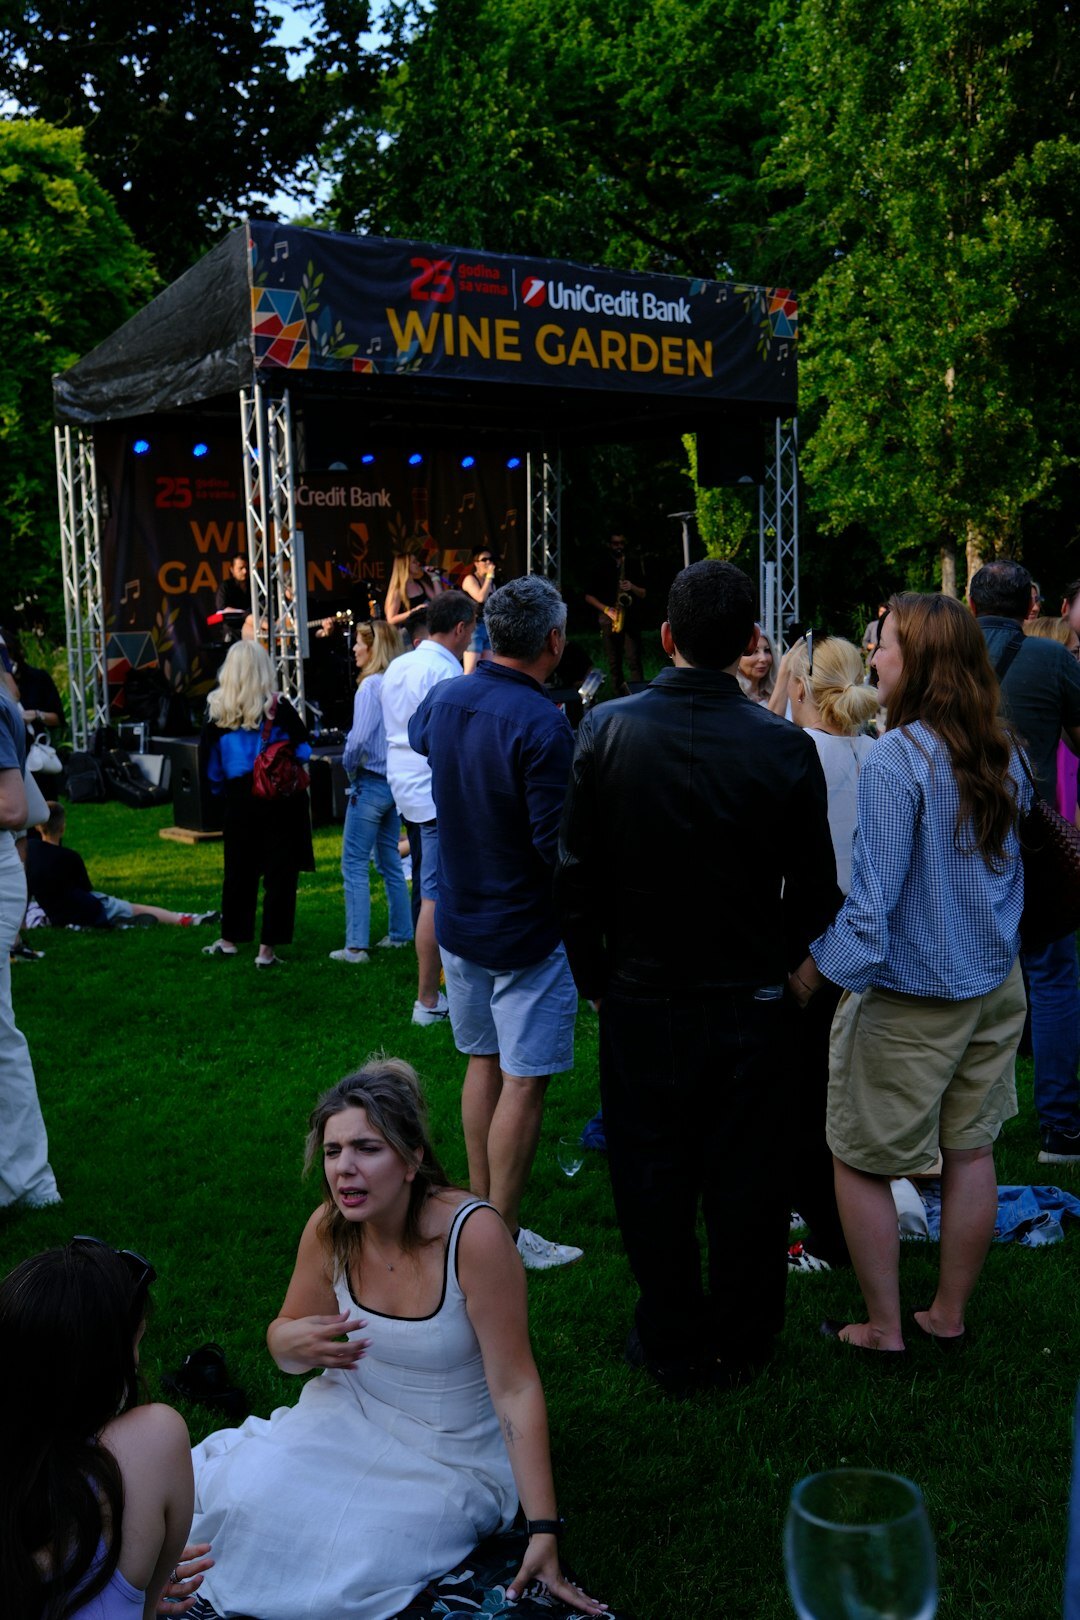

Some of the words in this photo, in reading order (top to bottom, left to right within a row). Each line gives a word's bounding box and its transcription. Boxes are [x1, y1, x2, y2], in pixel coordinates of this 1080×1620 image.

[410, 257, 455, 303] 25
[458, 263, 500, 280] godina
[458, 280, 473, 292] sa
[475, 281, 509, 296] vama
[548, 280, 640, 319] UniCredit
[642, 292, 692, 325] Bank
[385, 307, 522, 362] WINE
[534, 323, 714, 378] GARDEN
[154, 475, 193, 509] 25
[350, 486, 392, 508] Bank
[189, 519, 303, 554] WI
[157, 559, 334, 595] GAN
